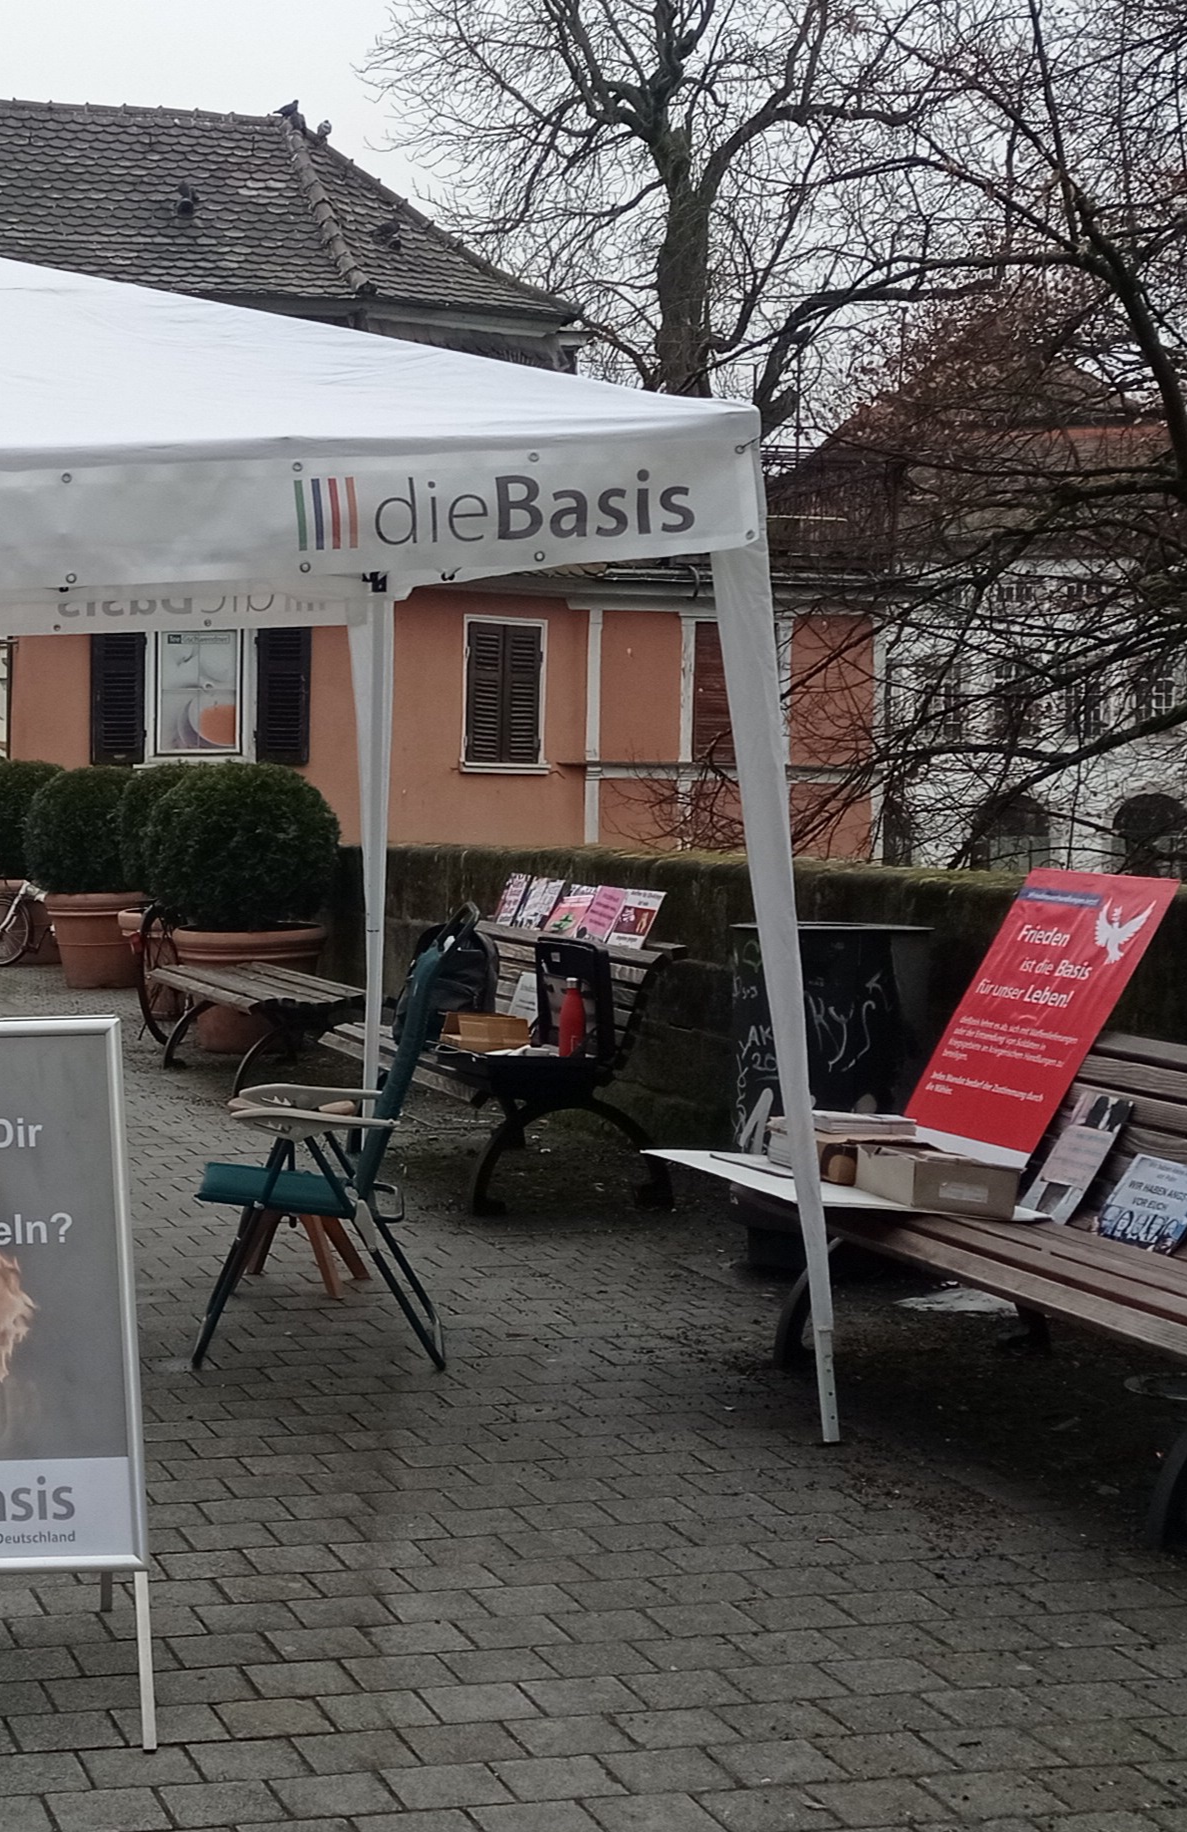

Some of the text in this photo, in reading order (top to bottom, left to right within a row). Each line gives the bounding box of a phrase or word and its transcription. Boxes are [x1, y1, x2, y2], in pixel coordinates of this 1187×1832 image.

[374, 468, 695, 546] dieBasis
[1017, 924, 1070, 947] Frieden
[1019, 957, 1093, 980] ist die Basis
[975, 978, 1075, 1008] für unser Leben!
